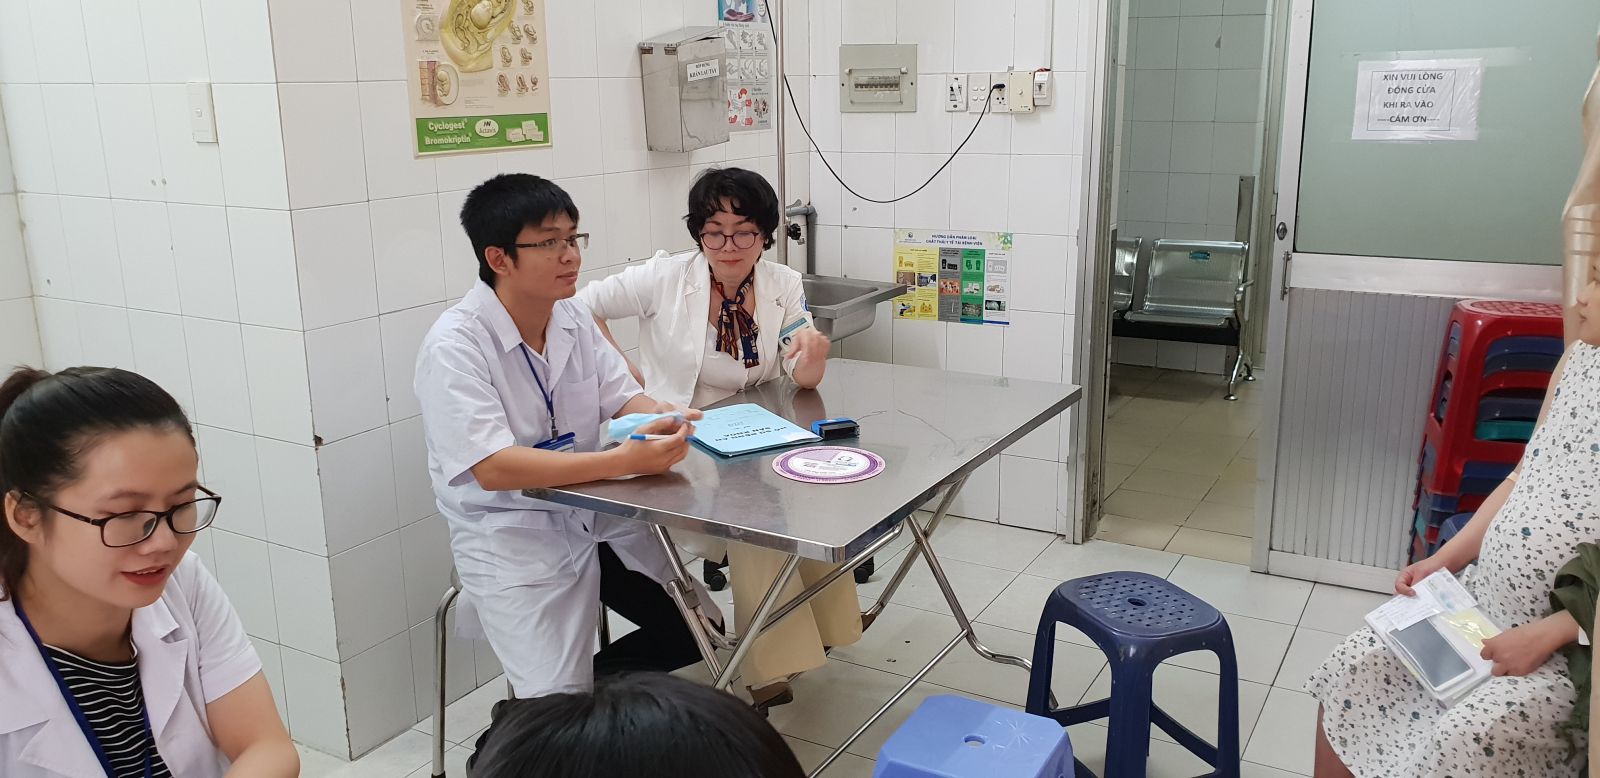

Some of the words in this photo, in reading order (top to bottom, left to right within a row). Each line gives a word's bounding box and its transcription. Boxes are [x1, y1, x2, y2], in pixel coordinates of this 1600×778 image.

[1383, 73, 1399, 81] XIN
[1400, 73, 1416, 81] VUI
[1418, 71, 1443, 81] LÒNG
[1387, 85, 1414, 95] ĐÓNG
[1416, 83, 1436, 94] CỬA
[1383, 101, 1398, 109] KHI
[1400, 101, 1412, 109] RA
[1414, 99, 1434, 109] VÀO
